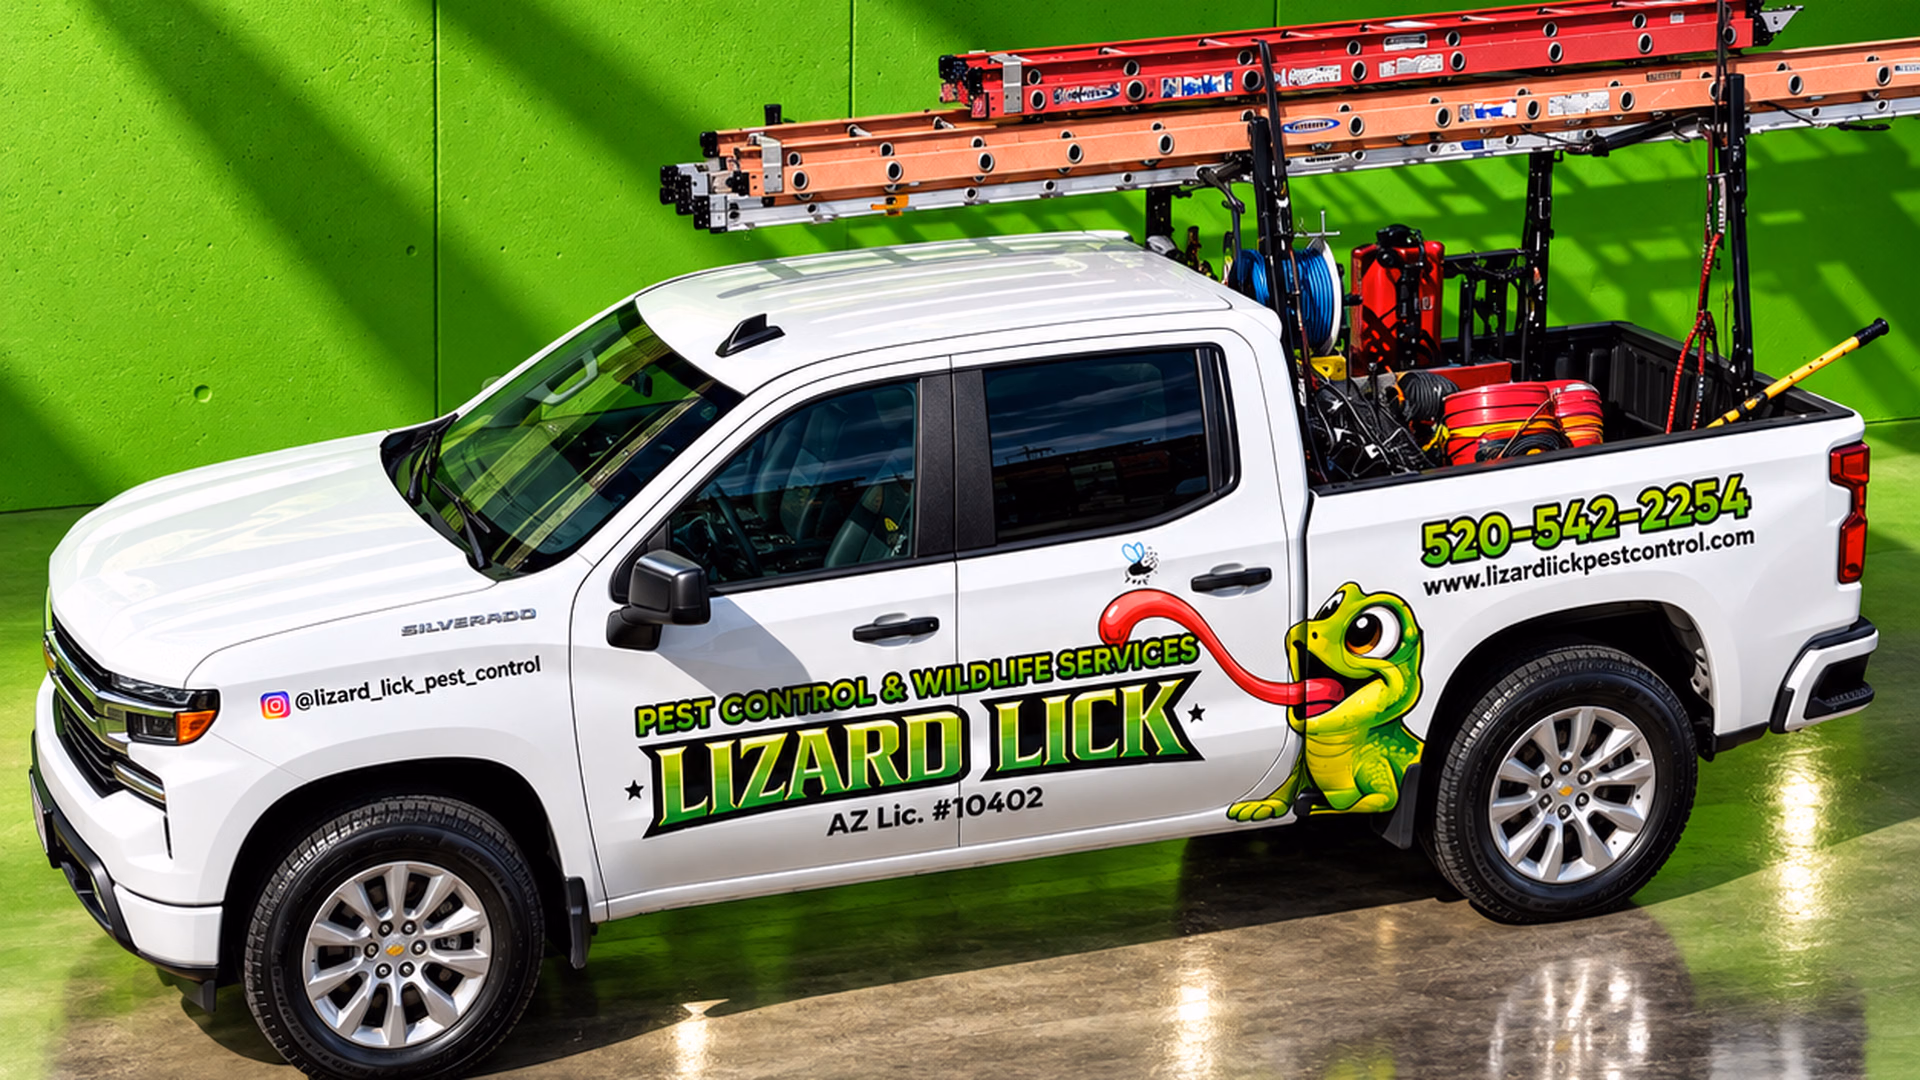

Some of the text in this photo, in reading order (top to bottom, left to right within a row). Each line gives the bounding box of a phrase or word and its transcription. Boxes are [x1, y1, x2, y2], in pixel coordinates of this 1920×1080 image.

[1421, 473, 1752, 567] 520-542-2254
[401, 608, 537, 636] SILVERADO
[295, 655, 541, 711] @lizard_lick_pest_control
[636, 634, 1201, 737] PEST CONTROL & WILDLIFE SERVICES
[655, 679, 1188, 827] LIZARD LICK
[827, 786, 1044, 836] AZ Lic. #10402
